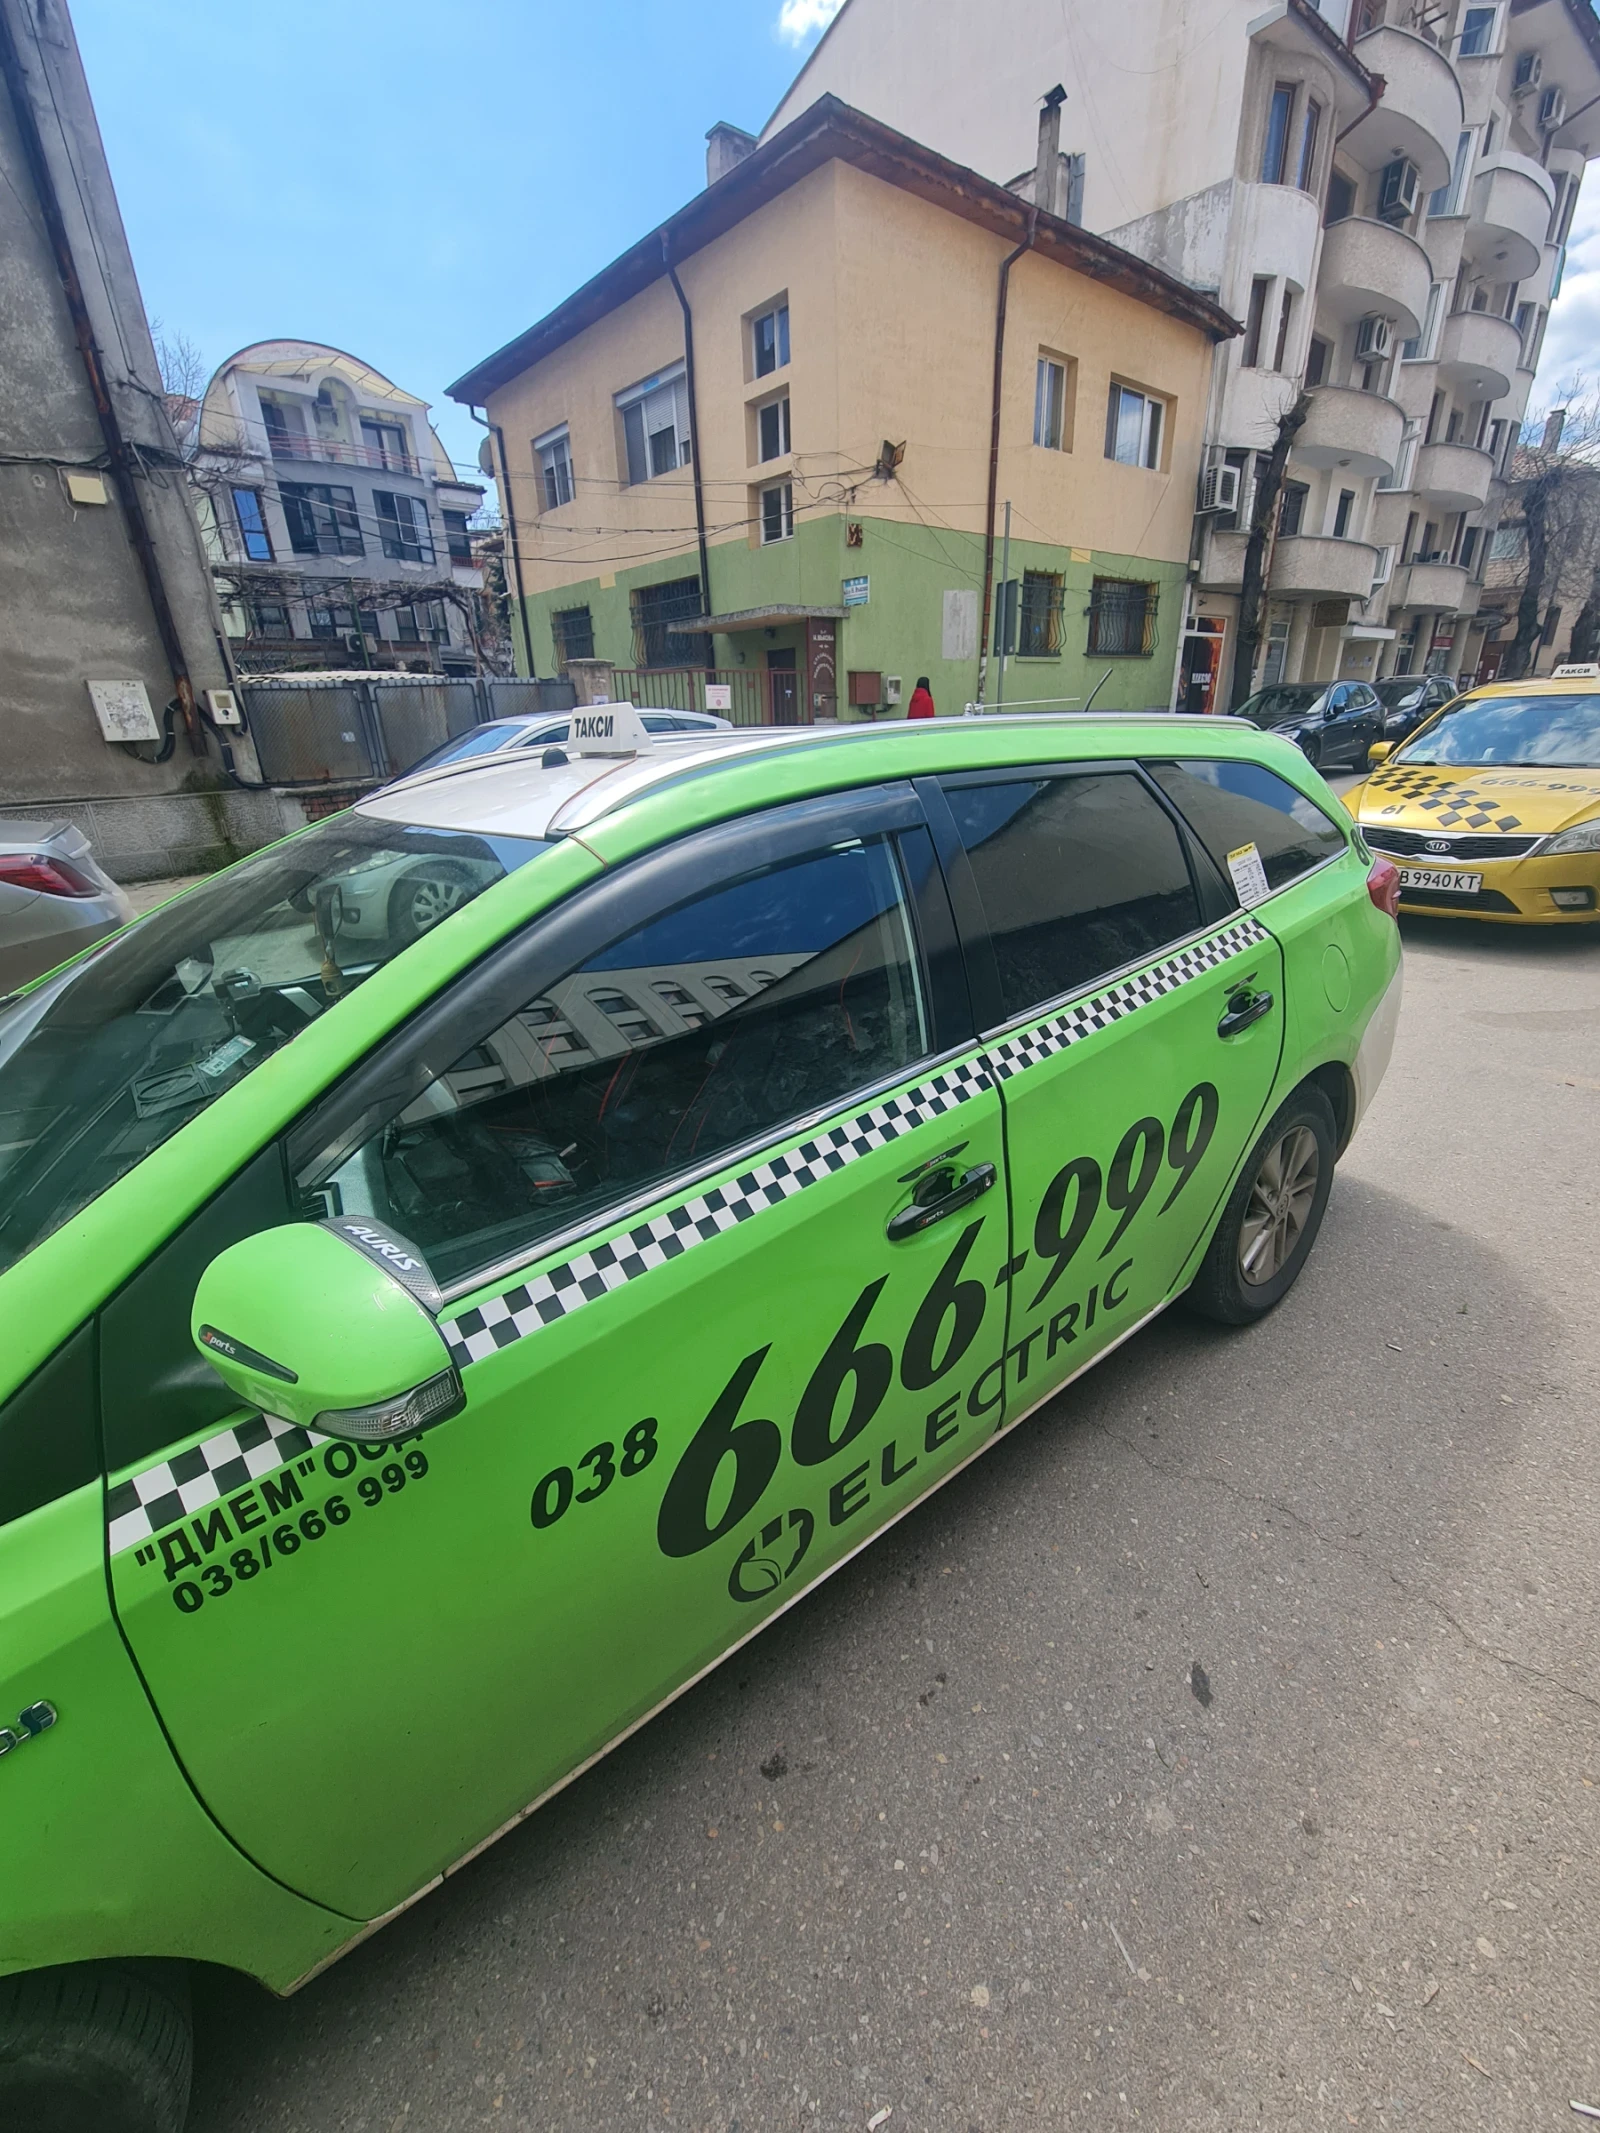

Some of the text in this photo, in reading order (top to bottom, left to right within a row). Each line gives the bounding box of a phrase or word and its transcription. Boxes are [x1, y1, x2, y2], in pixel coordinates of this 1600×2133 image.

[1560, 667, 1591, 675] ТАКСИ
[574, 715, 614, 738] ТАКСИ
[1380, 804, 1407, 815] 61
[1429, 842, 1448, 851] KIA
[1413, 872, 1452, 888] 9940
[342, 1224, 422, 1271] AURIS
[530, 1081, 1220, 1558] 038 666-999
[829, 1257, 1134, 1527] ELECTRIC
[172, 1449, 430, 1615] 038/666 999
